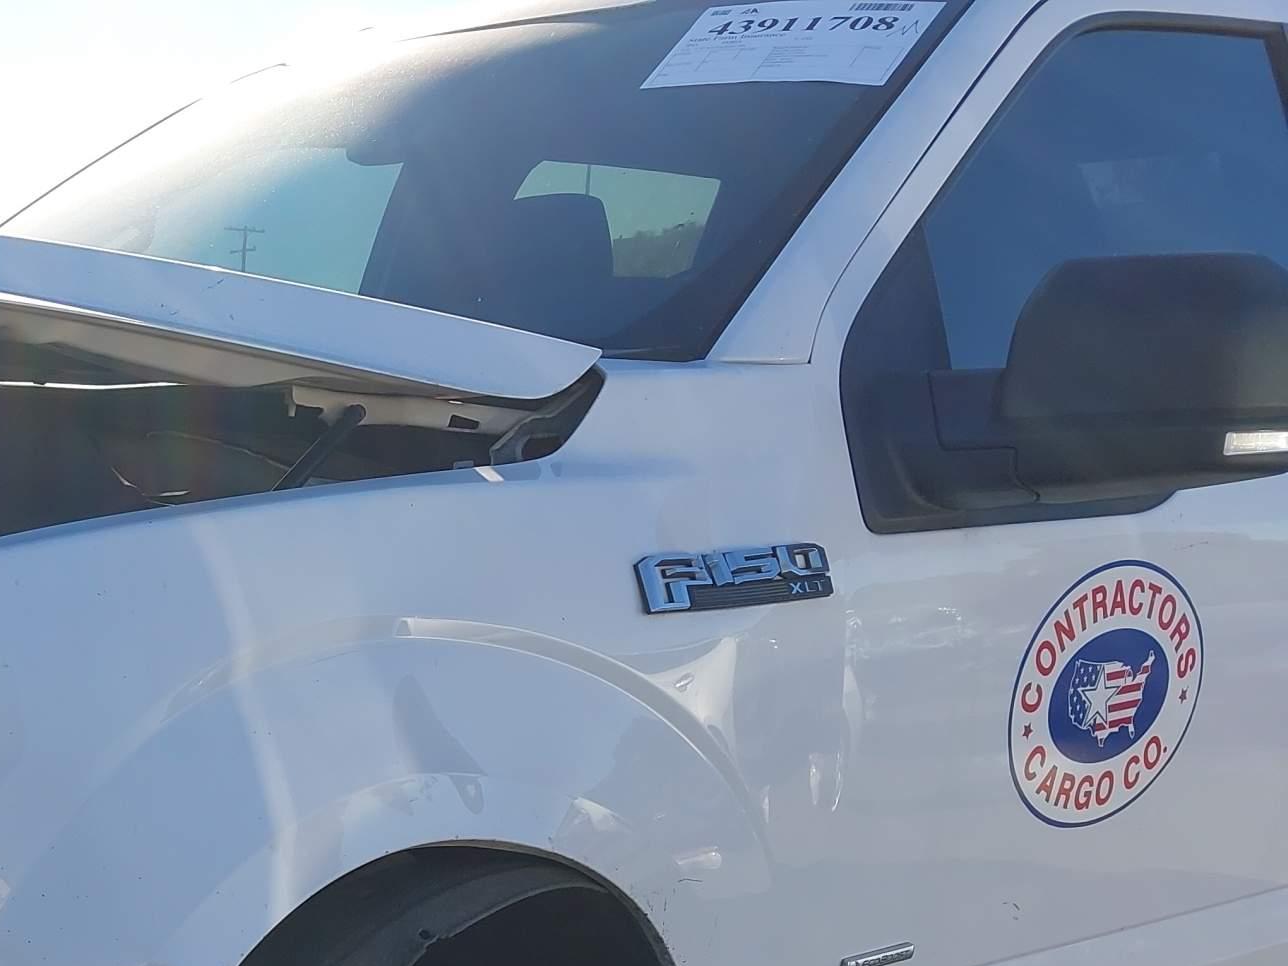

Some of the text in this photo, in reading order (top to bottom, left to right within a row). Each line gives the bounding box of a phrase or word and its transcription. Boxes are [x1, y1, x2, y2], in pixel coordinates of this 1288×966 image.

[708, 16, 900, 36] 43911708
[791, 578, 825, 595] XLT
[1021, 579, 1196, 713] CONTRACTORS
[1024, 736, 1168, 810] CARGO CO.
